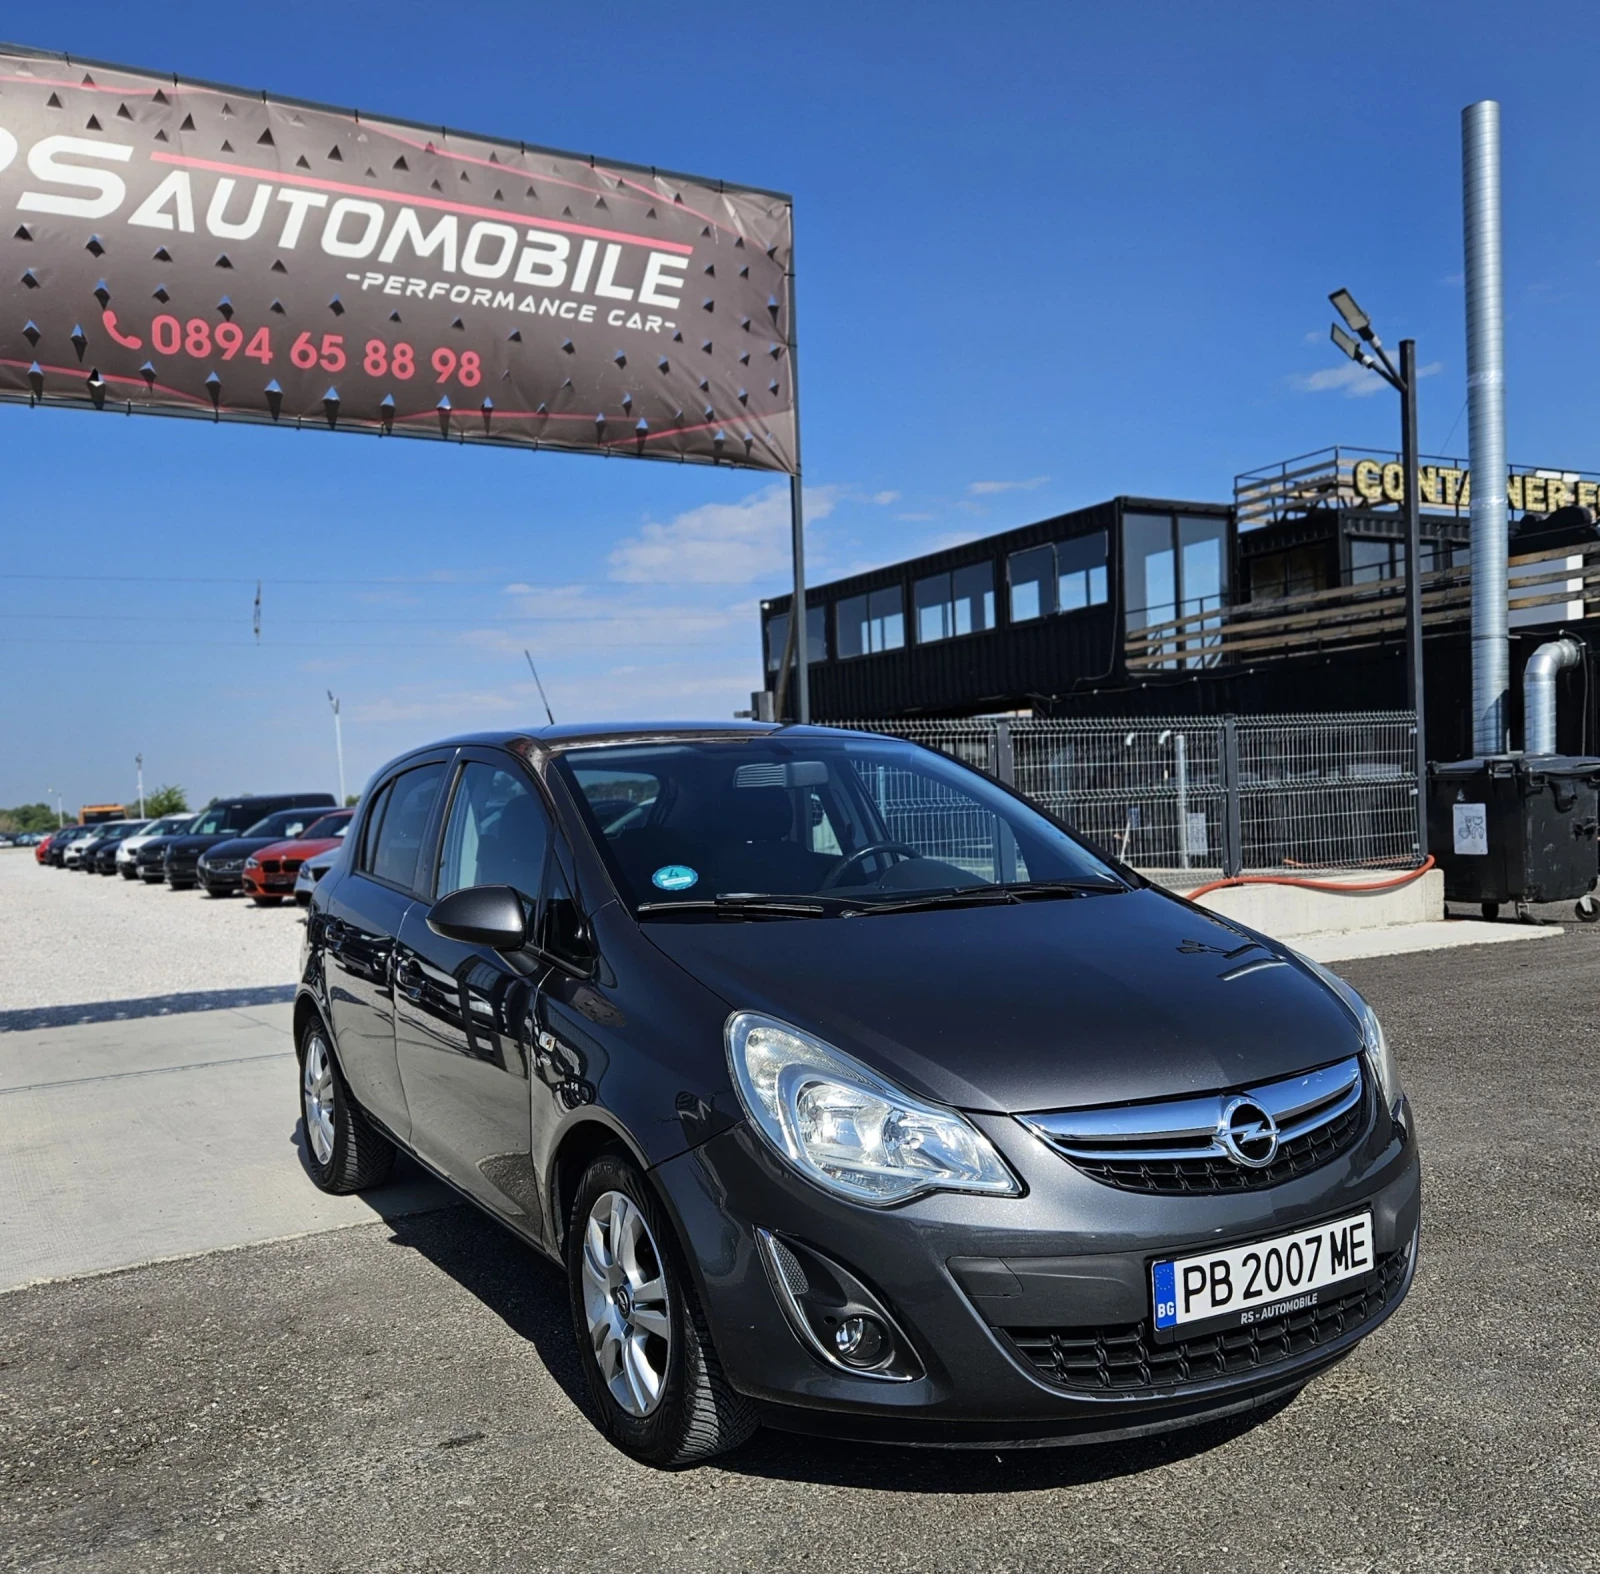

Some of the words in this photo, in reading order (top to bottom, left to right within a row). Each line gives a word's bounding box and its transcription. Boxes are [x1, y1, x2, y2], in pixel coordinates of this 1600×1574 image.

[0, 127, 134, 219] S
[128, 169, 690, 310] AUTOMOBILE
[151, 314, 274, 364] 0894
[290, 331, 346, 372] 65
[363, 339, 415, 380] 88
[431, 347, 482, 387] 98
[1355, 459, 1569, 513] CONTNER
[1183, 1259, 1233, 1313] PB
[1241, 1235, 1322, 1300] 2007
[1330, 1222, 1368, 1276] ME
[1157, 1301, 1175, 1319] BG
